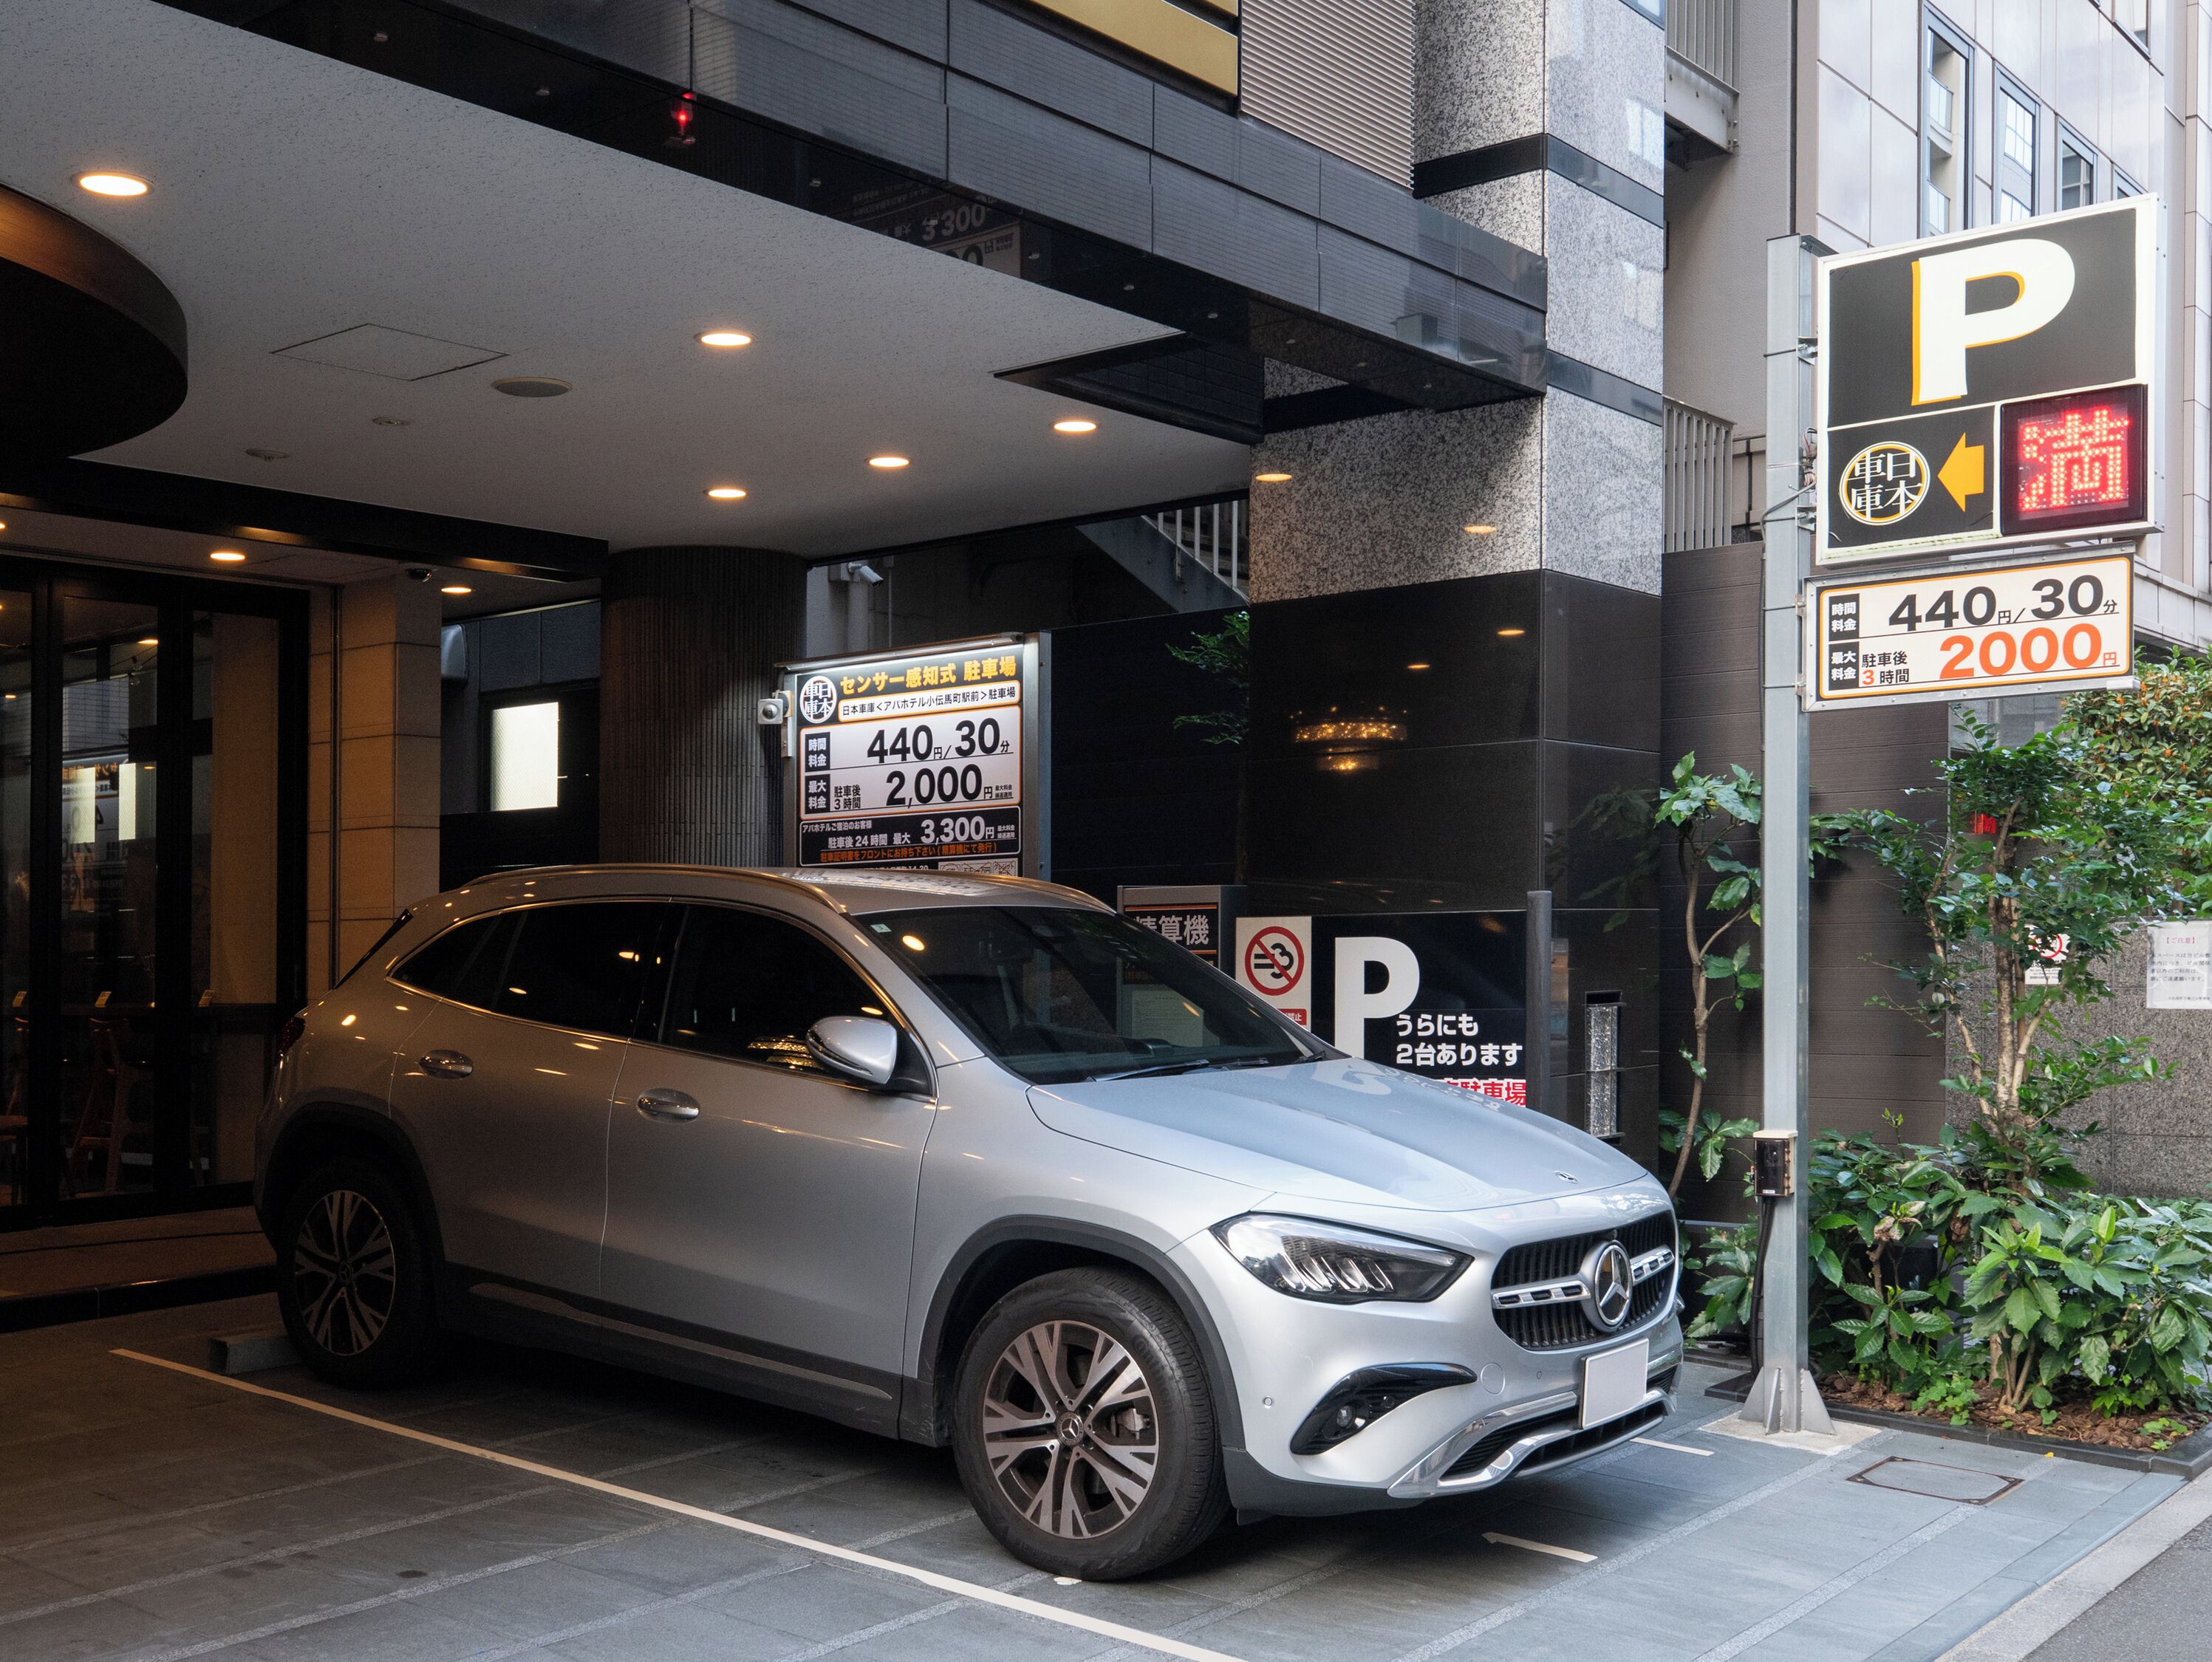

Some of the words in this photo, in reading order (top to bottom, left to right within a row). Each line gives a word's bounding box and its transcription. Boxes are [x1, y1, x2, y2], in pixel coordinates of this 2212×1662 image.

[1911, 239, 2075, 406] P
[2021, 408, 2129, 510] 満
[1832, 601, 1857, 616] 時間
[1832, 618, 1857, 632] 料金
[1832, 651, 1857, 665] 最大
[1862, 651, 1908, 668] 駐車後
[840, 664, 956, 694] センサー感知式
[963, 655, 1017, 680] 駐車場
[1832, 666, 1857, 681] 料金
[808, 737, 827, 751] 時間
[808, 753, 827, 767] 料金
[808, 779, 827, 793] 最大
[834, 784, 861, 799] 駐車後
[808, 796, 827, 810] 料金
[893, 832, 911, 845] 最大
[1334, 937, 1420, 1059] P
[1396, 1013, 1478, 1036] うらにも
[1396, 1043, 1523, 1067] 2台あります
